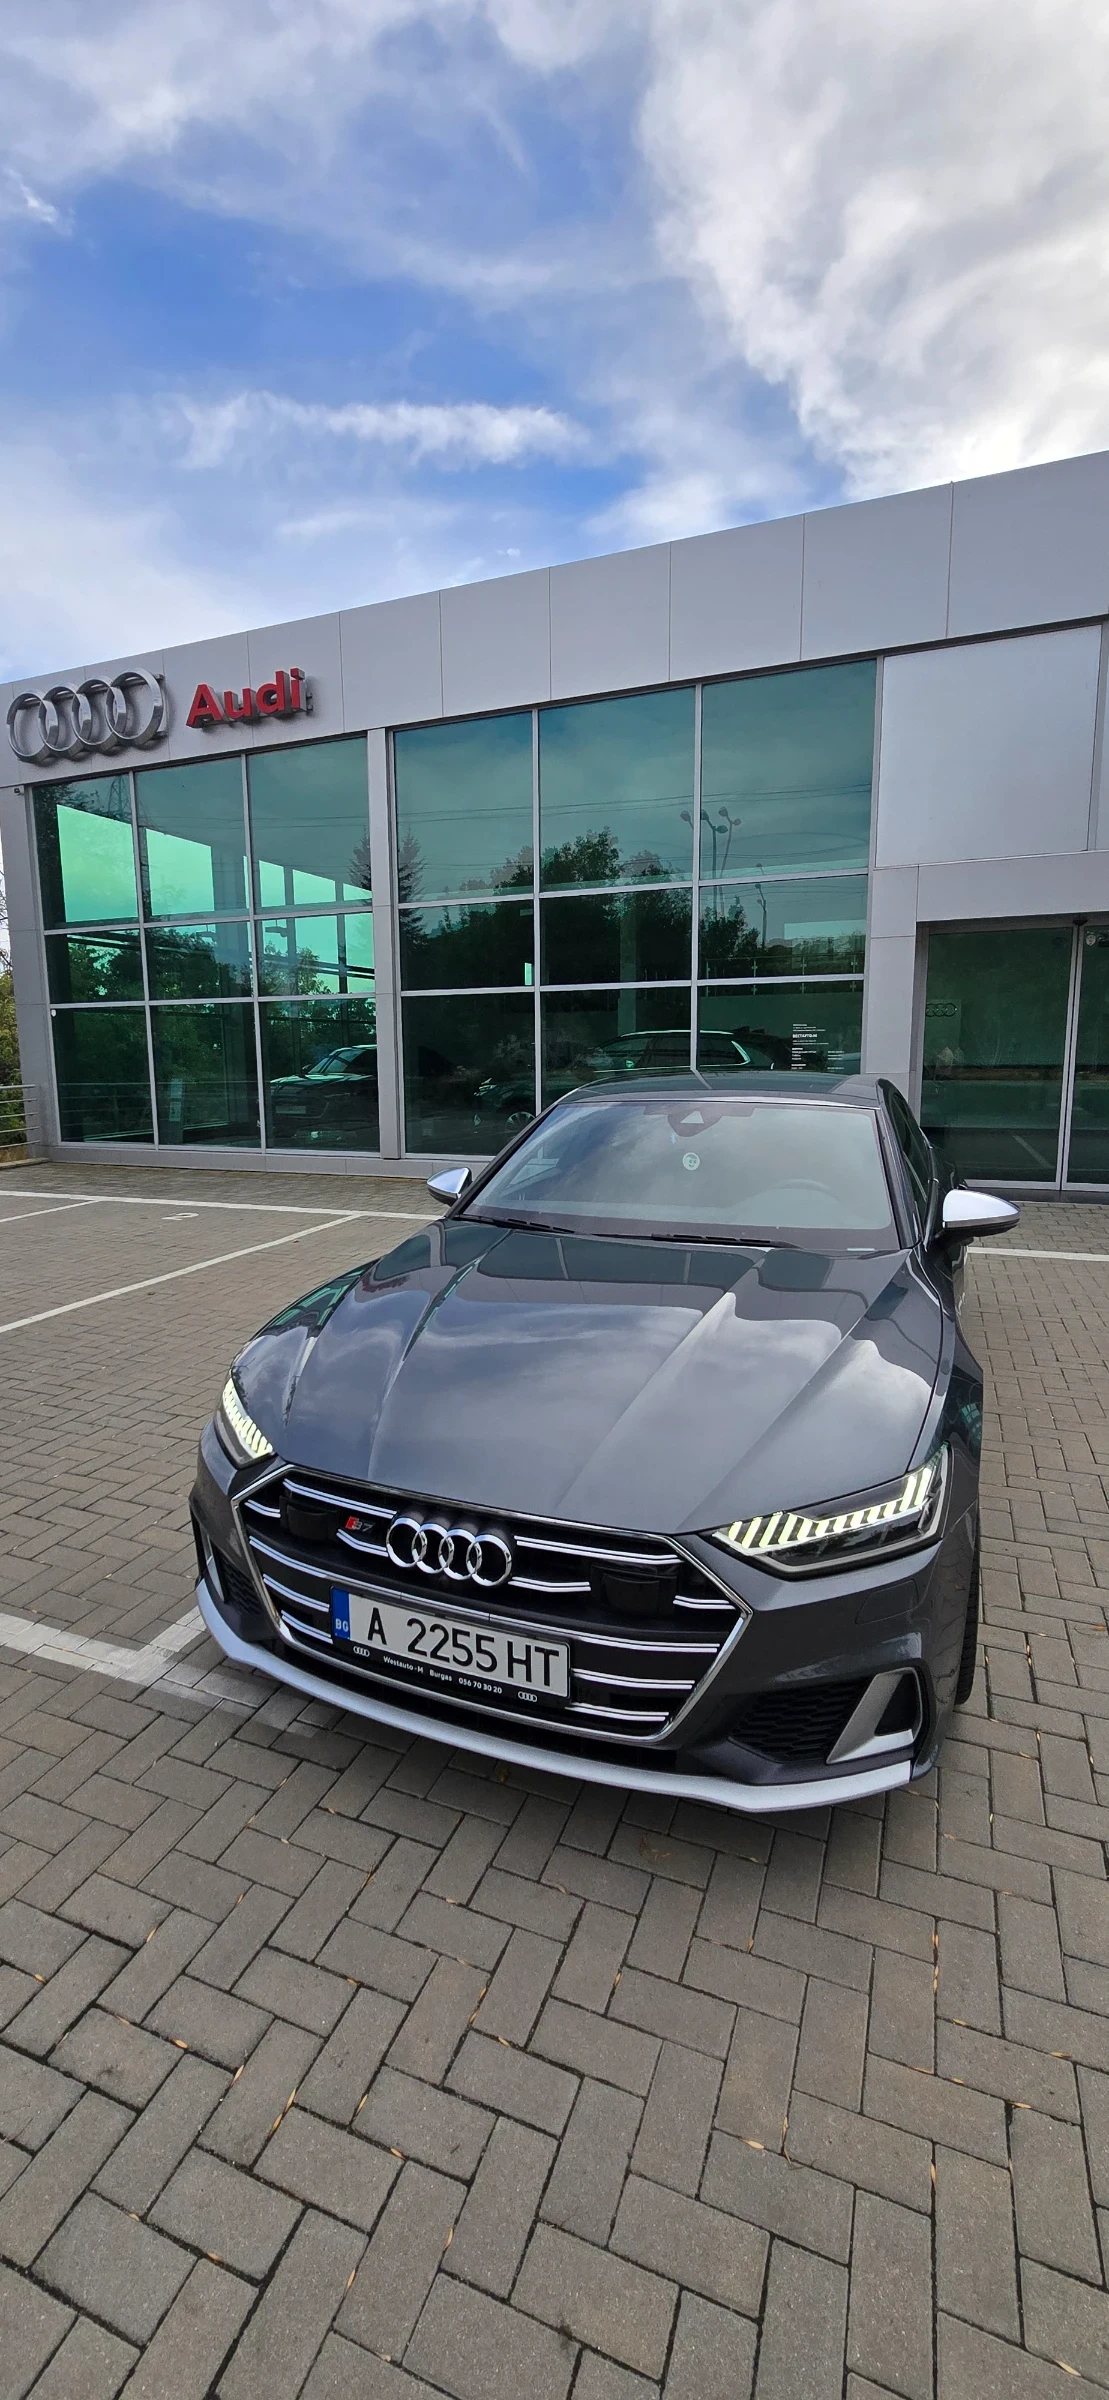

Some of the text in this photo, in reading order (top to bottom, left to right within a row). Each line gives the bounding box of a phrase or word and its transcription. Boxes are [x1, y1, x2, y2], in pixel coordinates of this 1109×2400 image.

[186, 667, 305, 728] Audi
[335, 1617, 349, 1633] BG
[367, 1606, 560, 1687] A 2255 HT
[429, 1669, 453, 1682] Burgas
[458, 1677, 472, 1687] 056
[473, 1681, 482, 1689] 70
[483, 1683, 492, 1692] 30
[493, 1686, 503, 1694] 20
